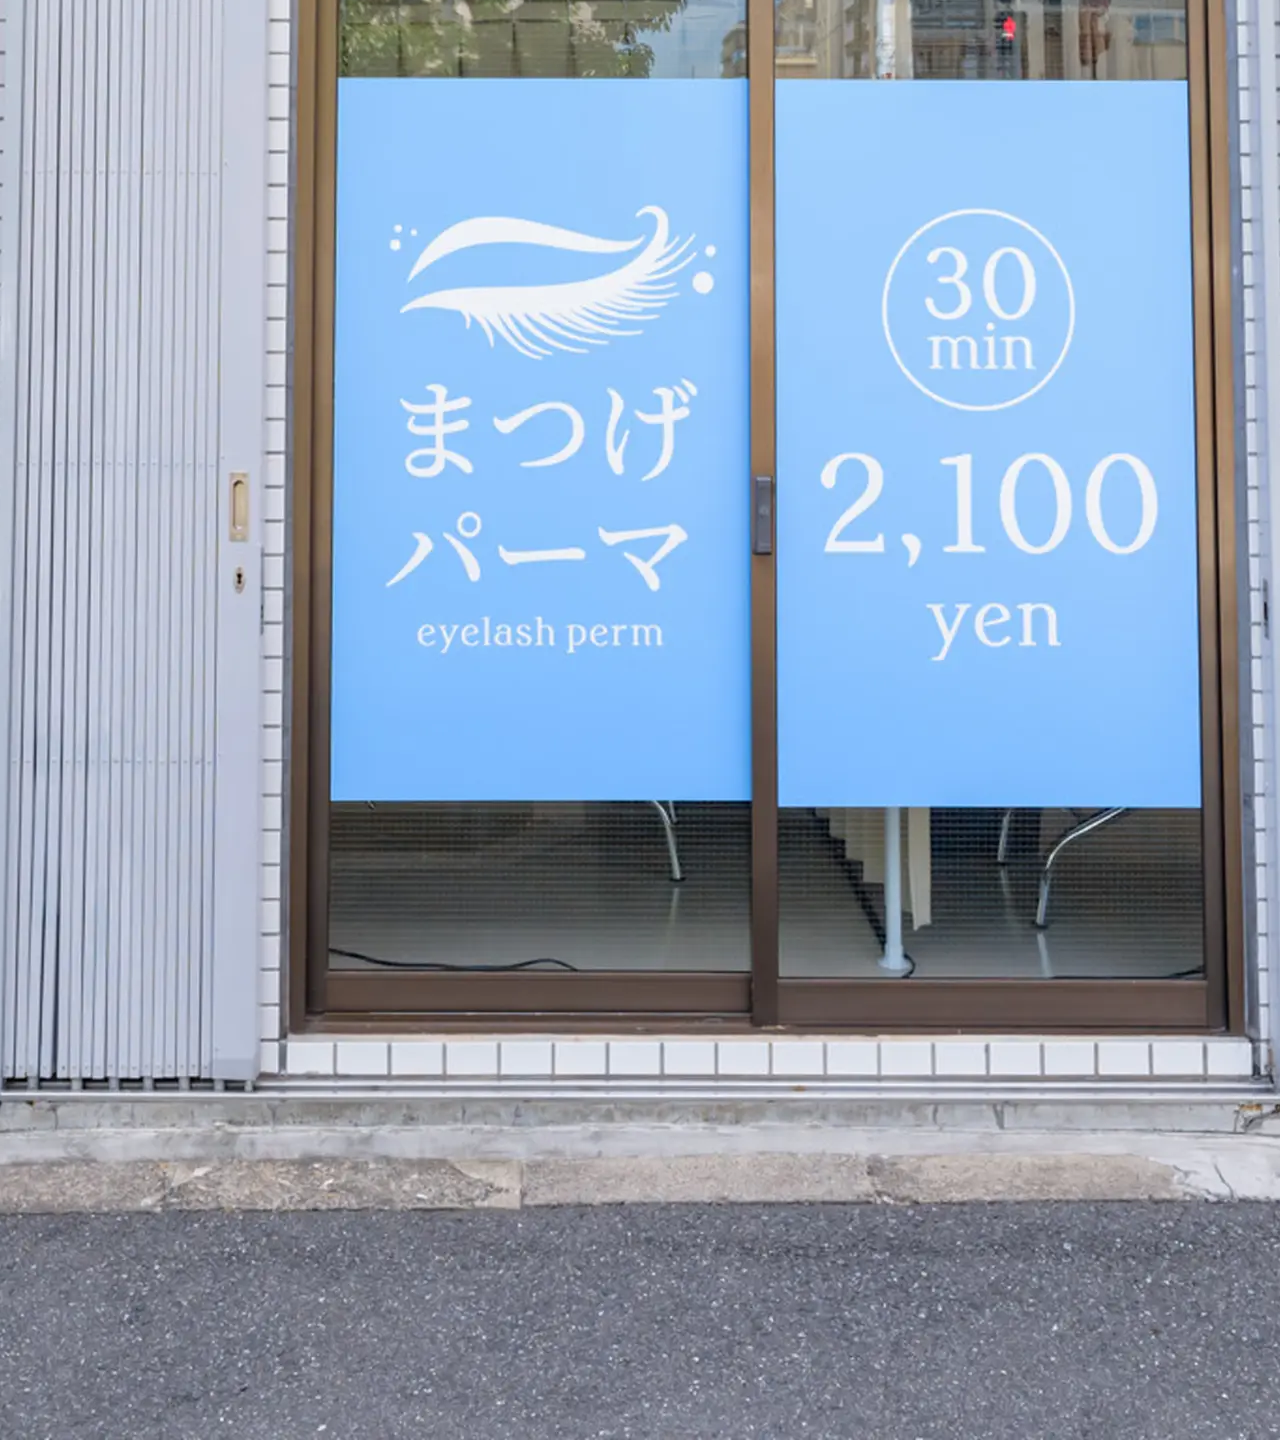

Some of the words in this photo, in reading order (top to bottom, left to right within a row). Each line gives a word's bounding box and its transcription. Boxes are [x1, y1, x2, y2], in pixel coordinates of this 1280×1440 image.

[924, 246, 1037, 321] 30
[927, 323, 1036, 370] min
[399, 378, 698, 482] まつげ
[820, 452, 1159, 568] 2,100
[385, 511, 689, 592] パーマ
[416, 615, 556, 655] eyelash
[565, 624, 664, 654] perm
[926, 602, 1062, 662] yen
